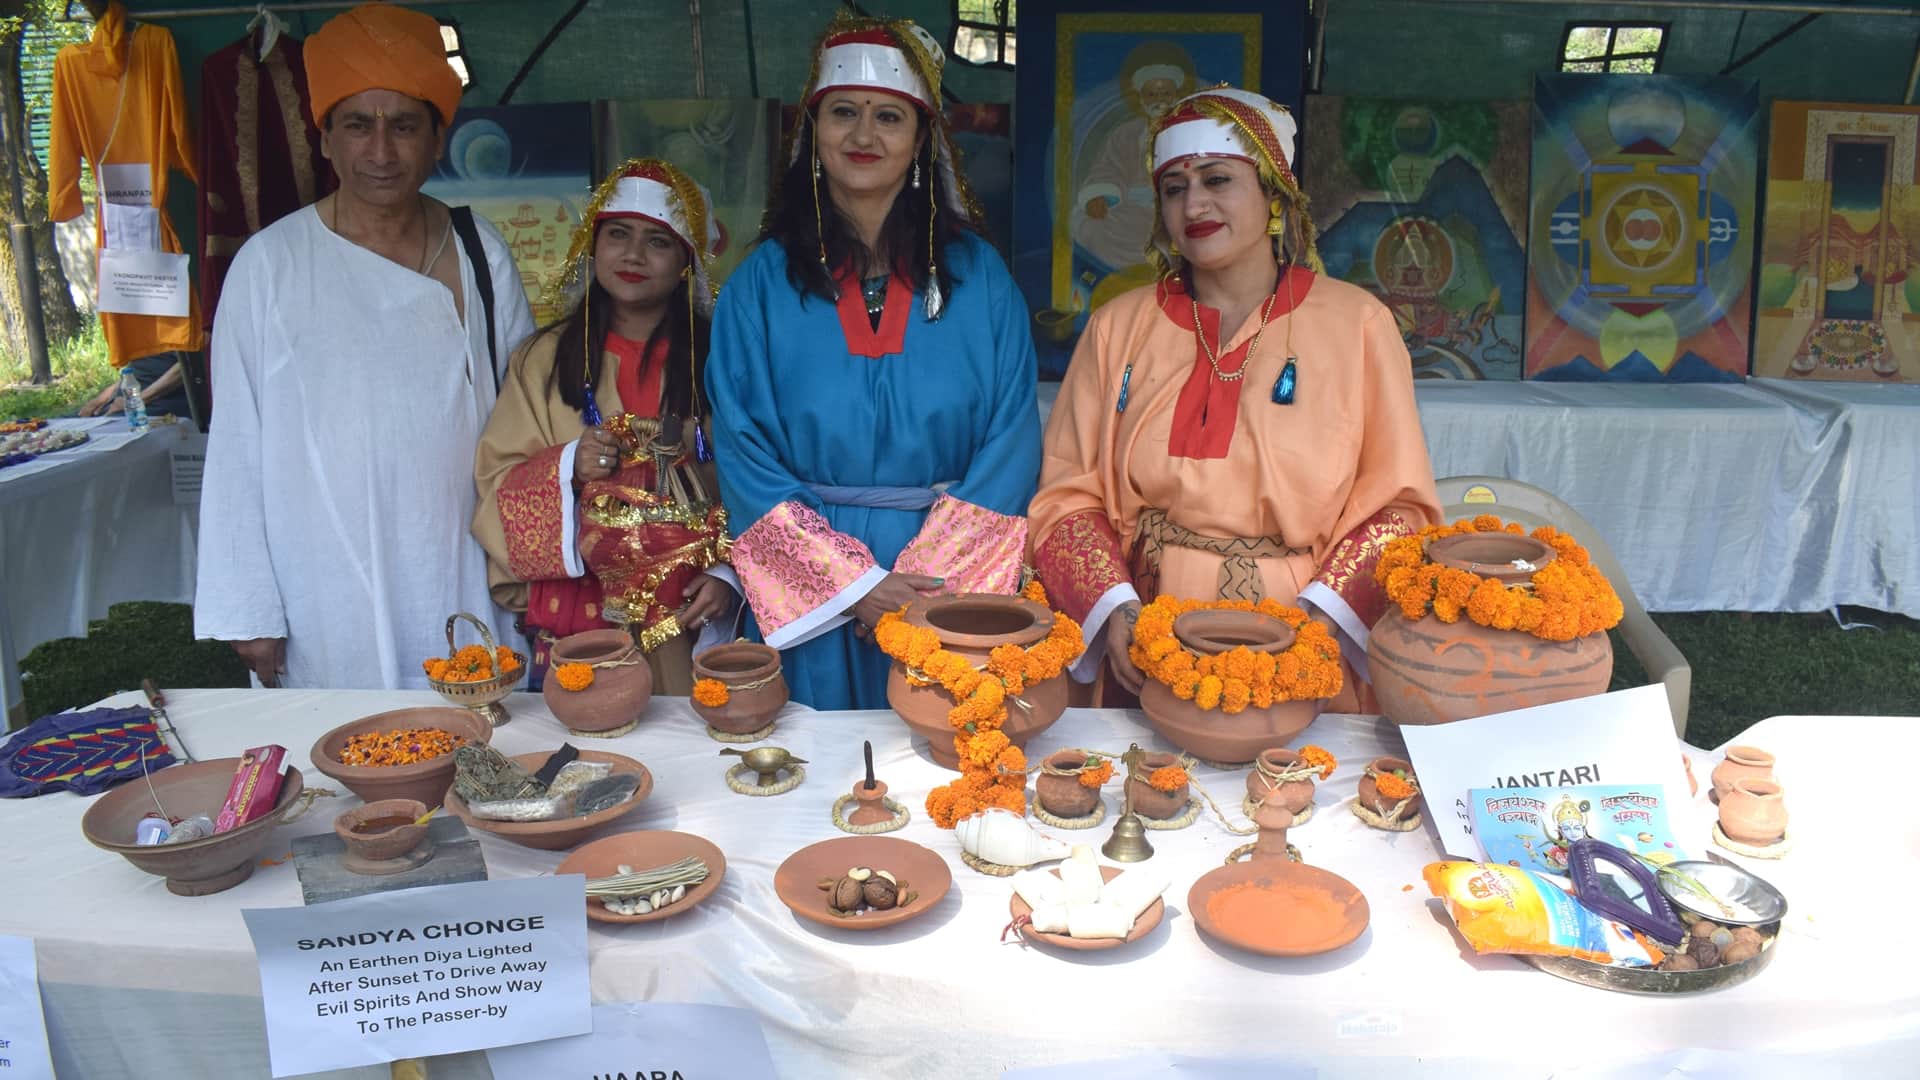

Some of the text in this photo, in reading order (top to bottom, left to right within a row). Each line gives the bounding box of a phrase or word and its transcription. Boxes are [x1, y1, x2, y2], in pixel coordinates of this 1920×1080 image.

[1491, 764, 1600, 788] JANTARI
[297, 915, 545, 950] SANDYA CHONGE
[320, 942, 533, 972] An Earthen Diya Lighted
[309, 960, 547, 995] After Sunset To Drive Away
[317, 980, 543, 1017] Evil Spirits And Show Way
[356, 1004, 508, 1034] To The Passer-by
